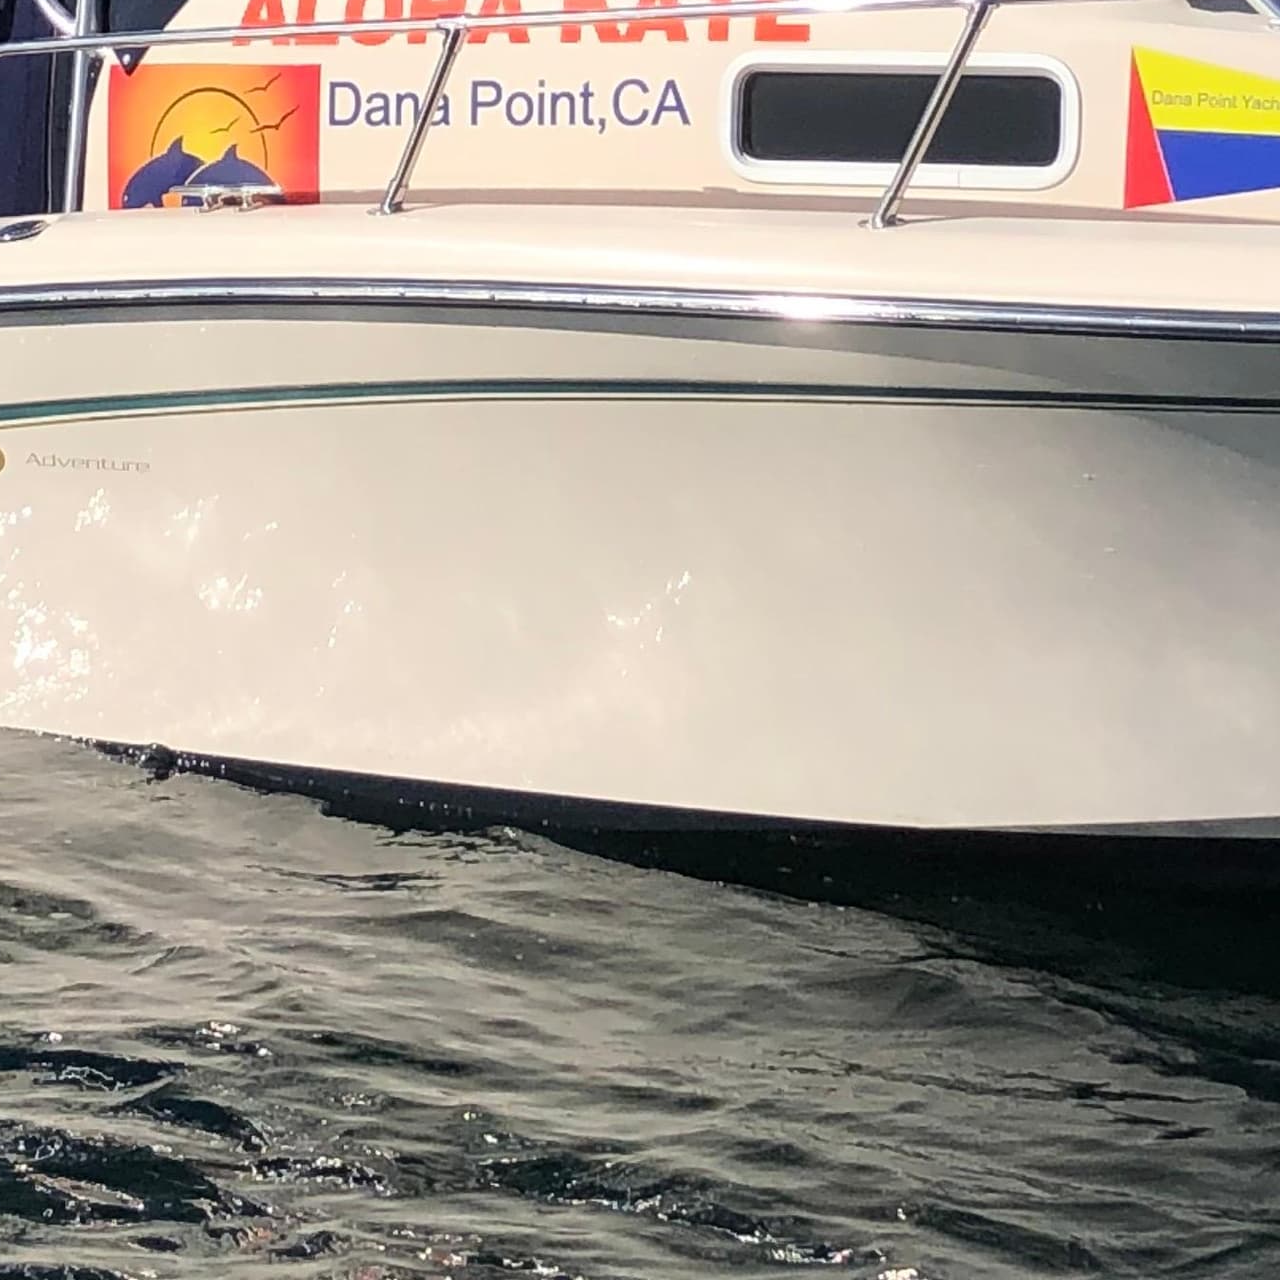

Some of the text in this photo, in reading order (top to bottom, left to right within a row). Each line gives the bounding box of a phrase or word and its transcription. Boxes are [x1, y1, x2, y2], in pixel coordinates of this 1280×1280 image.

[328, 80, 450, 127] Dana
[1151, 90, 1192, 106] Dana
[1197, 93, 1237, 109] Point
[24, 452, 152, 473] Adventure
